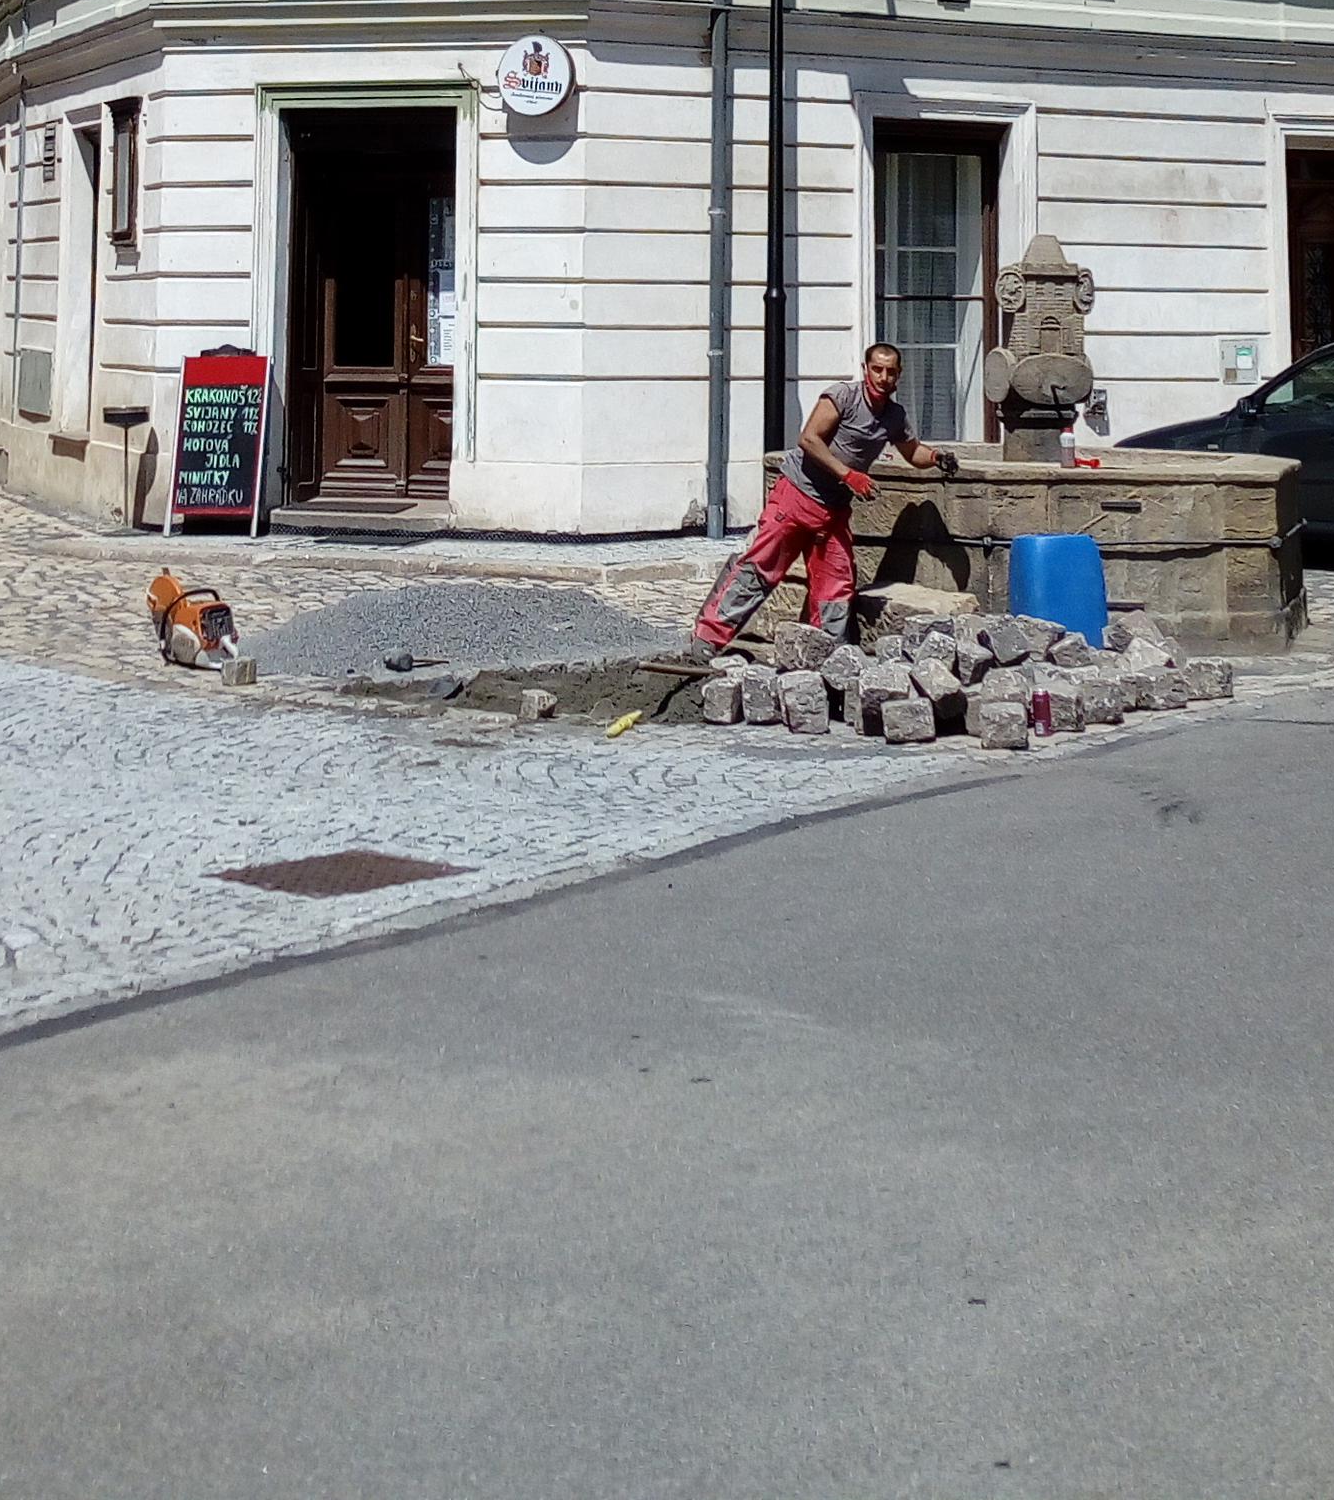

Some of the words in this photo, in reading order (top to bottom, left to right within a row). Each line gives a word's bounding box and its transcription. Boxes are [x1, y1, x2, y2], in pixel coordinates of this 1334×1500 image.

[503, 71, 562, 94] Svijany
[184, 385, 247, 405] KRAKONOŠ
[184, 405, 237, 420] SVIJANY
[183, 420, 234, 434] ROHOZEC
[183, 434, 233, 453] HOTOVÁ
[178, 470, 229, 486] MINUTKY
